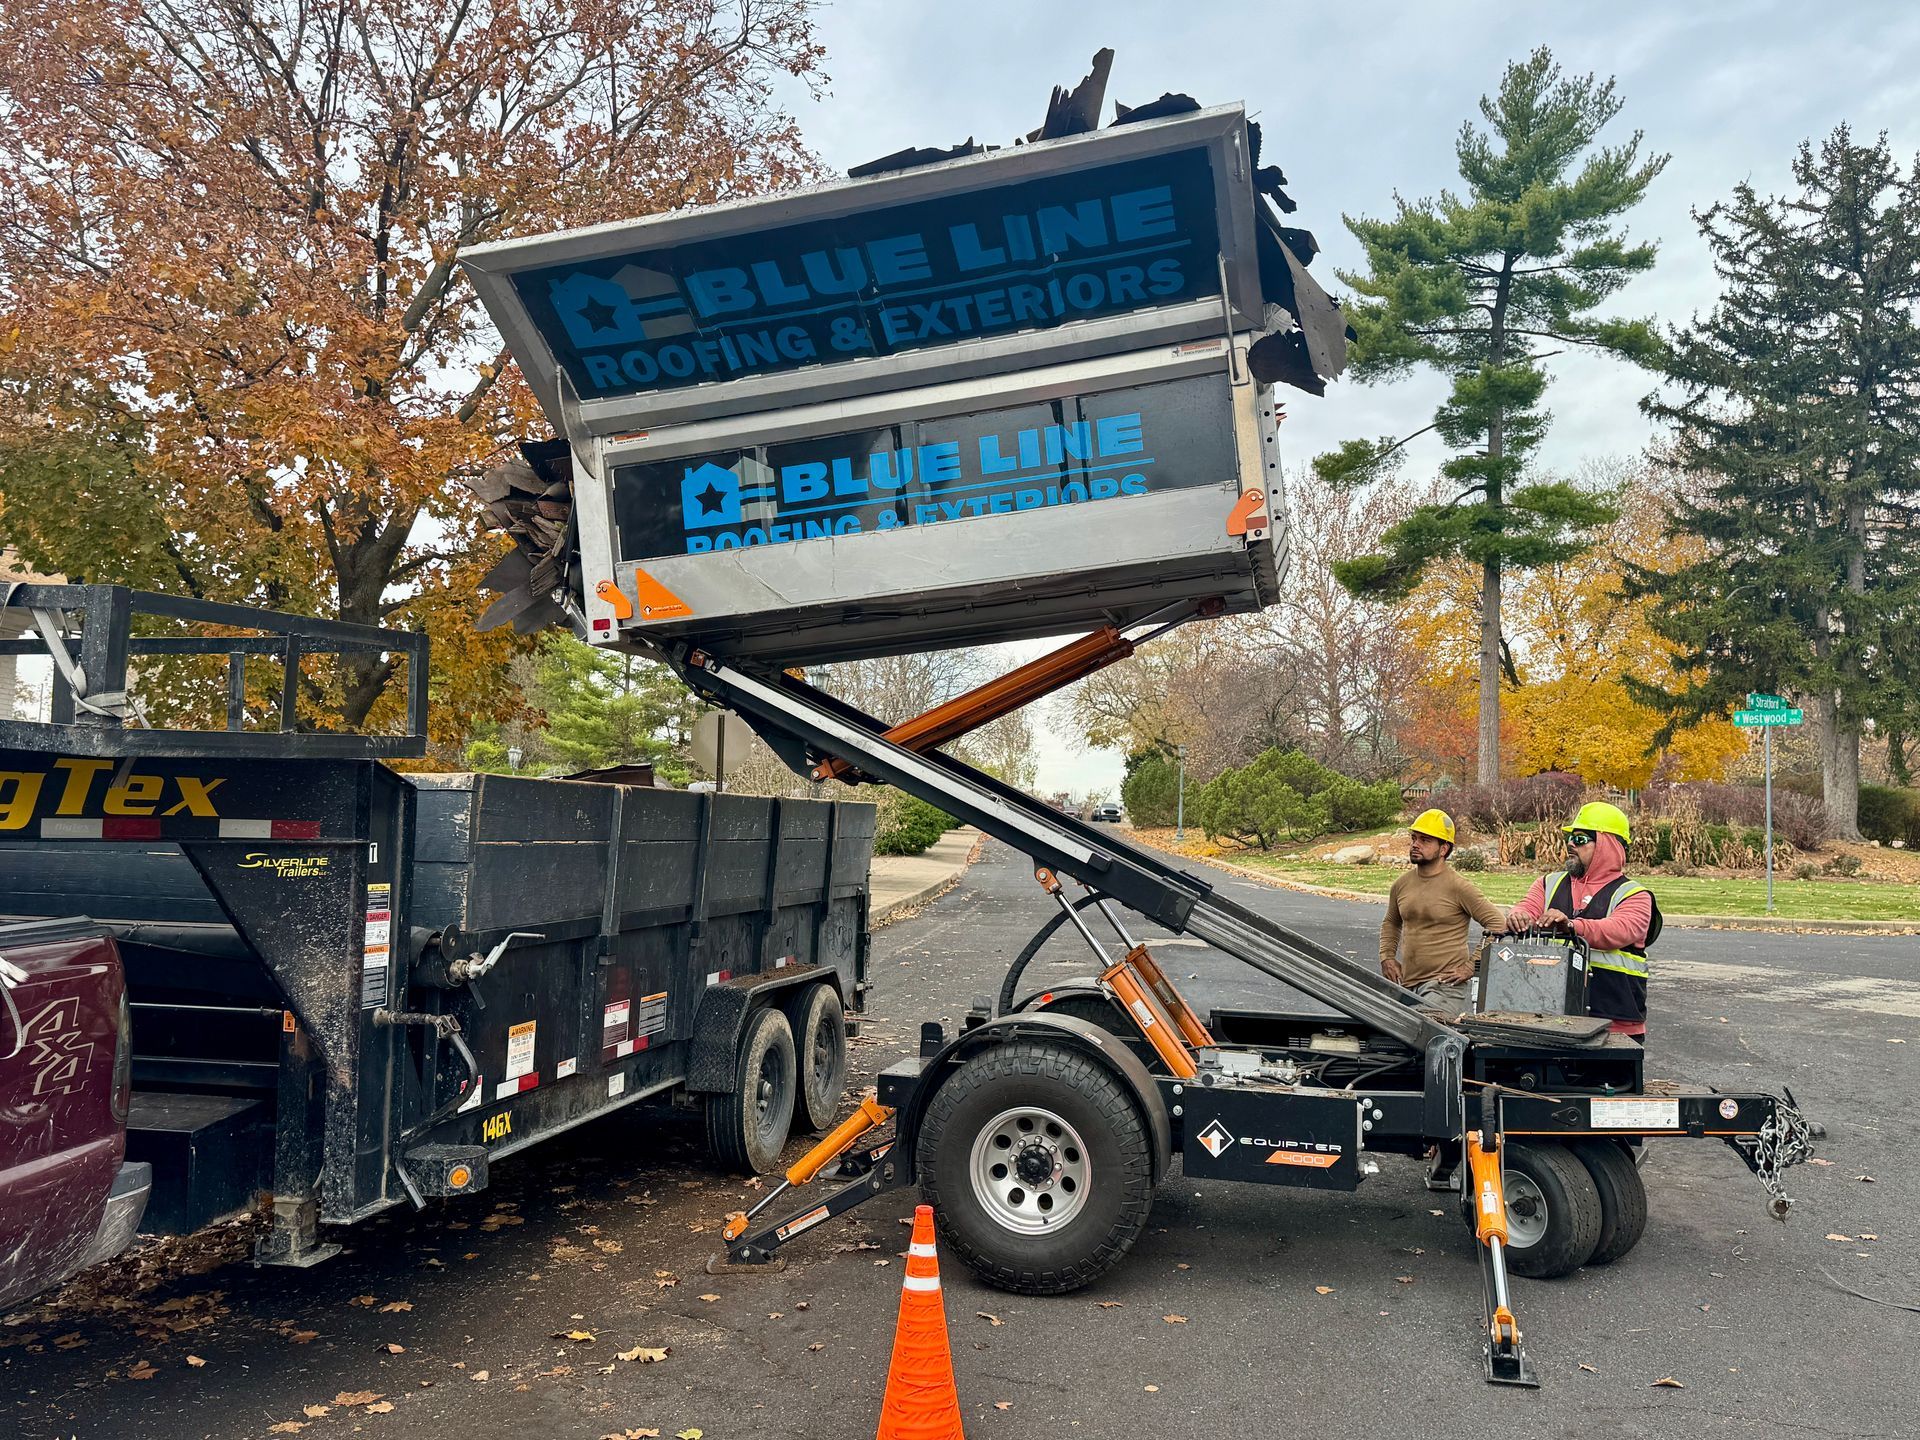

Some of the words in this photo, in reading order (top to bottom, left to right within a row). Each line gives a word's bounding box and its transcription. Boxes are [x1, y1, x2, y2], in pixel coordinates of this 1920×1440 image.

[684, 233, 933, 318] BLUE
[949, 186, 1176, 271] LINE
[582, 326, 816, 388] ROOFING
[830, 317, 872, 351] &
[879, 259, 1185, 345] EXTERIORS
[781, 441, 961, 503] BLUE
[979, 413, 1143, 475] LINE
[1755, 696, 1779, 709] Stratford
[1742, 712, 1787, 724] Westwood
[237, 853, 328, 868] SILVERLINE
[276, 866, 319, 877] Trailers
[515, 1024, 533, 1034] WARNING
[482, 1110, 512, 1143] 14GX
[1239, 1137, 1342, 1152] EQUIPTER
[1281, 1153, 1325, 1165] 4000
